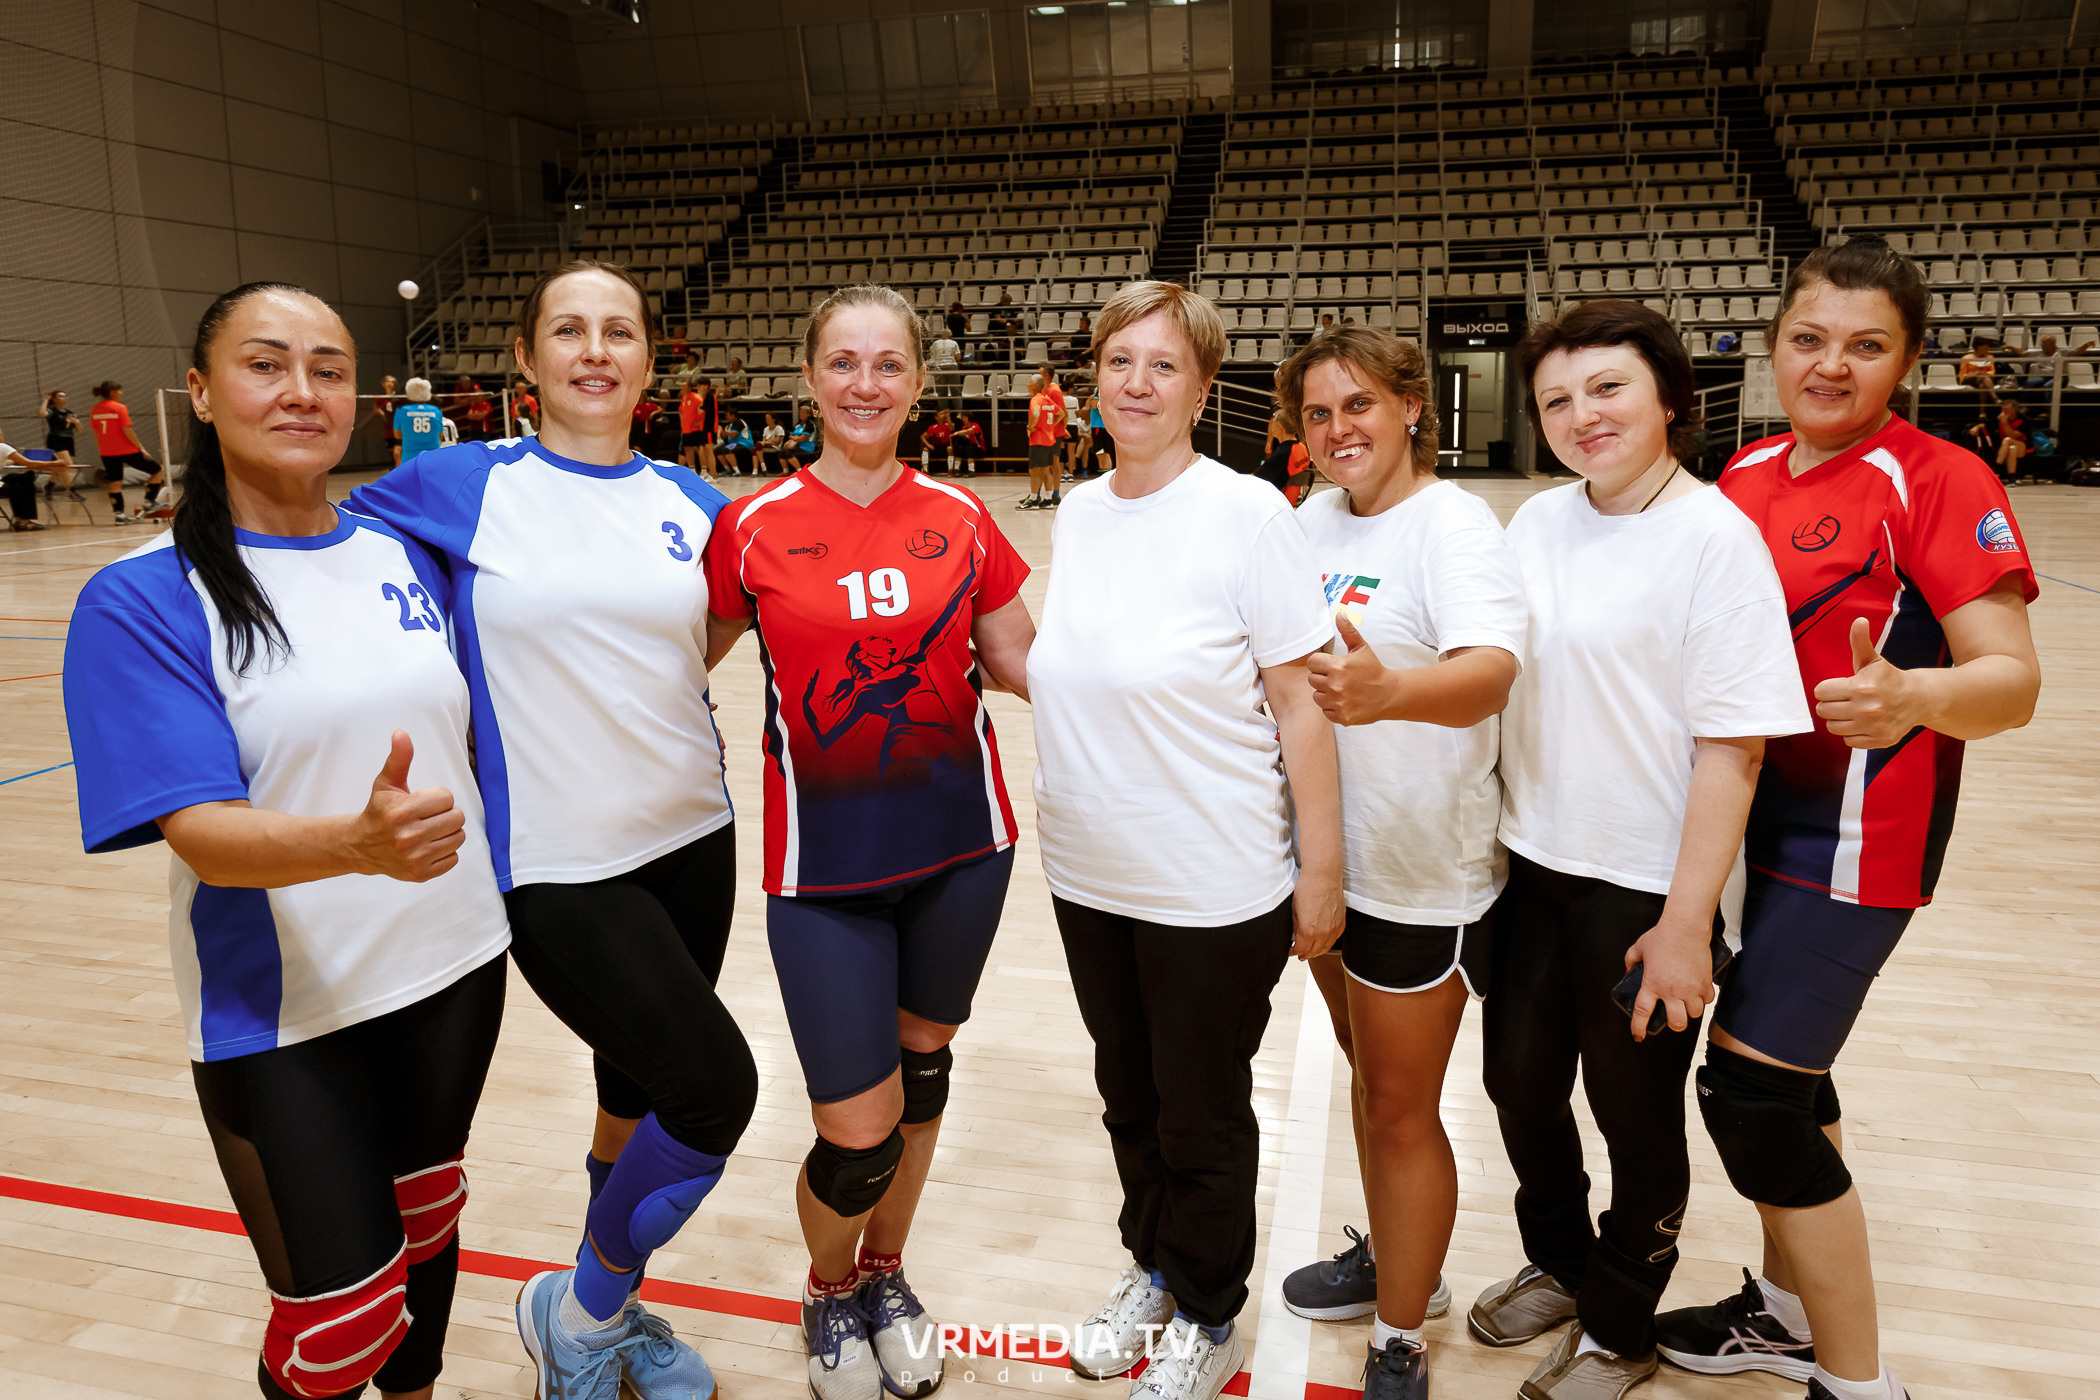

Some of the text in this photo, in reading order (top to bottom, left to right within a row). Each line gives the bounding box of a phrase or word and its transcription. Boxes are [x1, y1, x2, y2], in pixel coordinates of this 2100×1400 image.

[1443, 323, 1509, 334] ВЫХОД
[413, 417, 431, 433] 85
[661, 521, 693, 562] 3
[381, 582, 441, 633] 23
[836, 567, 911, 620] 19
